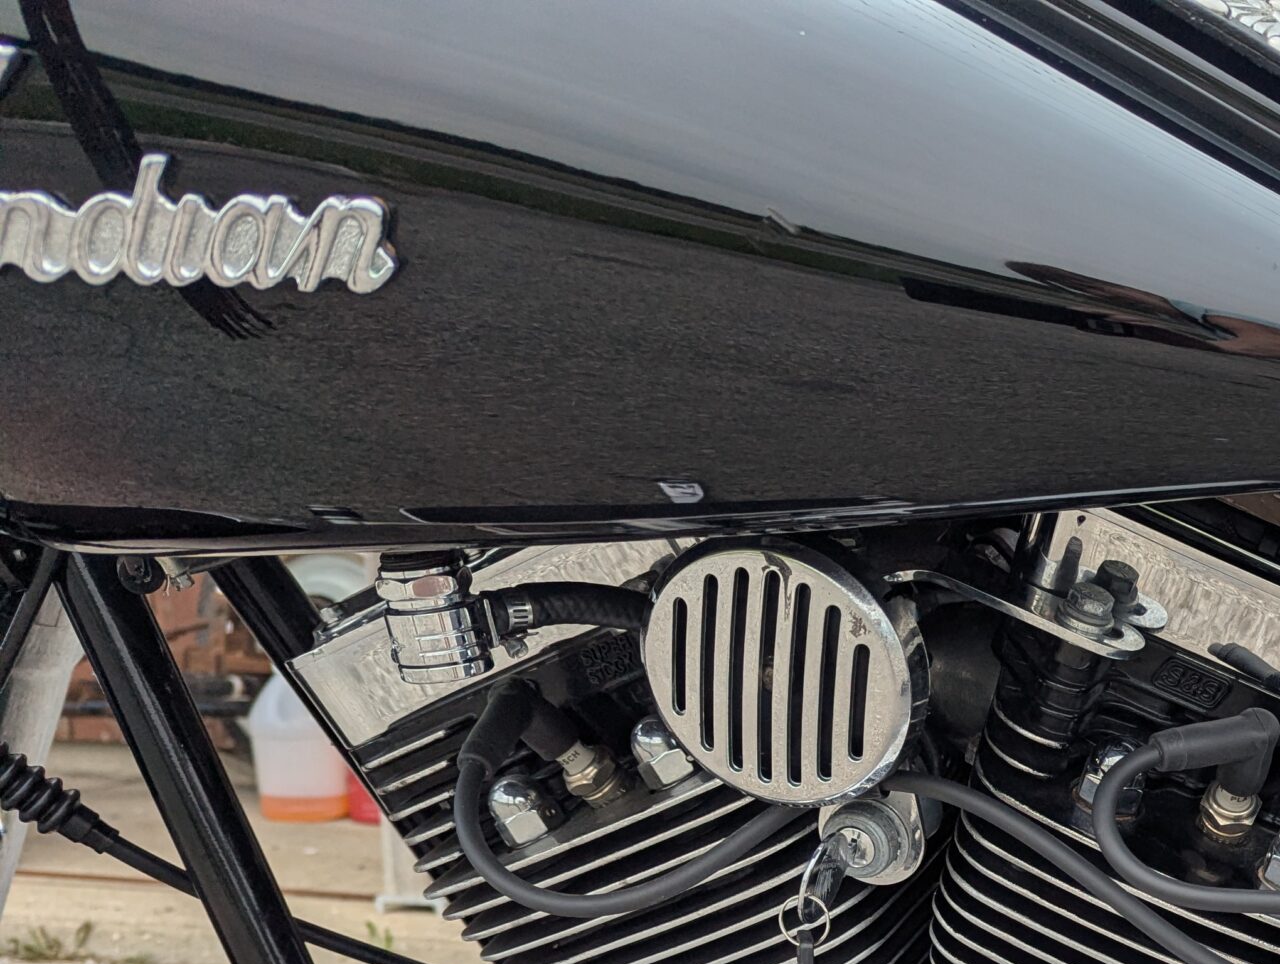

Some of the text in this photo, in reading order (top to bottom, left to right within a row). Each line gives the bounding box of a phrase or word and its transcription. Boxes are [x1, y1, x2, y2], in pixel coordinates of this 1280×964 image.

[0, 153, 395, 294] ndian
[1161, 664, 1220, 702] S&S
[561, 749, 581, 766] SCH
